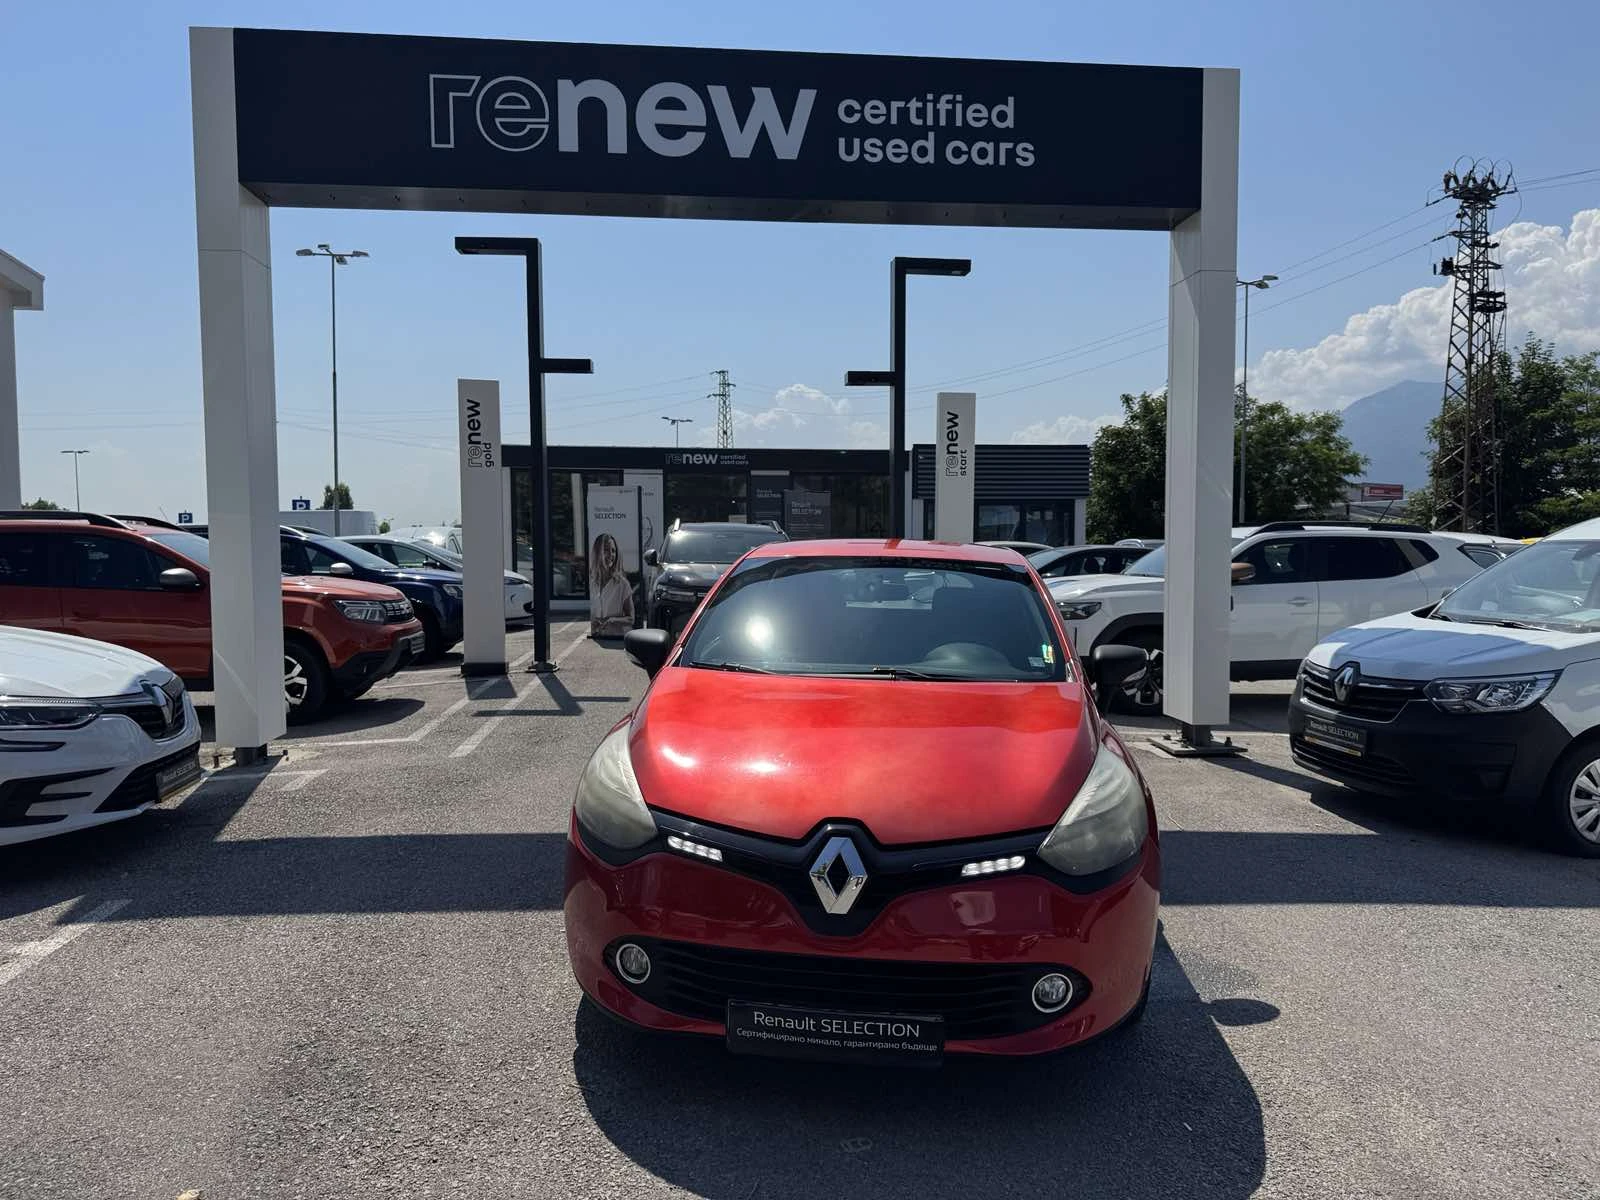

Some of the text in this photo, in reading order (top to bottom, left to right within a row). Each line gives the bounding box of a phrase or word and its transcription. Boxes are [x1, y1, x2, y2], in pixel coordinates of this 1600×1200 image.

[429, 74, 818, 160] renew
[837, 93, 1015, 129] certified
[838, 131, 1037, 167] used cars
[467, 399, 482, 468] renew
[946, 411, 959, 477] renew
[483, 442, 494, 467] gold
[665, 453, 719, 465] renew
[959, 449, 968, 477] start
[594, 512, 627, 520] SELECTION
[753, 1011, 920, 1037] Renault SELECTION
[736, 1027, 806, 1043] Сертифицирано
[843, 1038, 900, 1049] гарантирано
[901, 1041, 938, 1052] бъдеще
